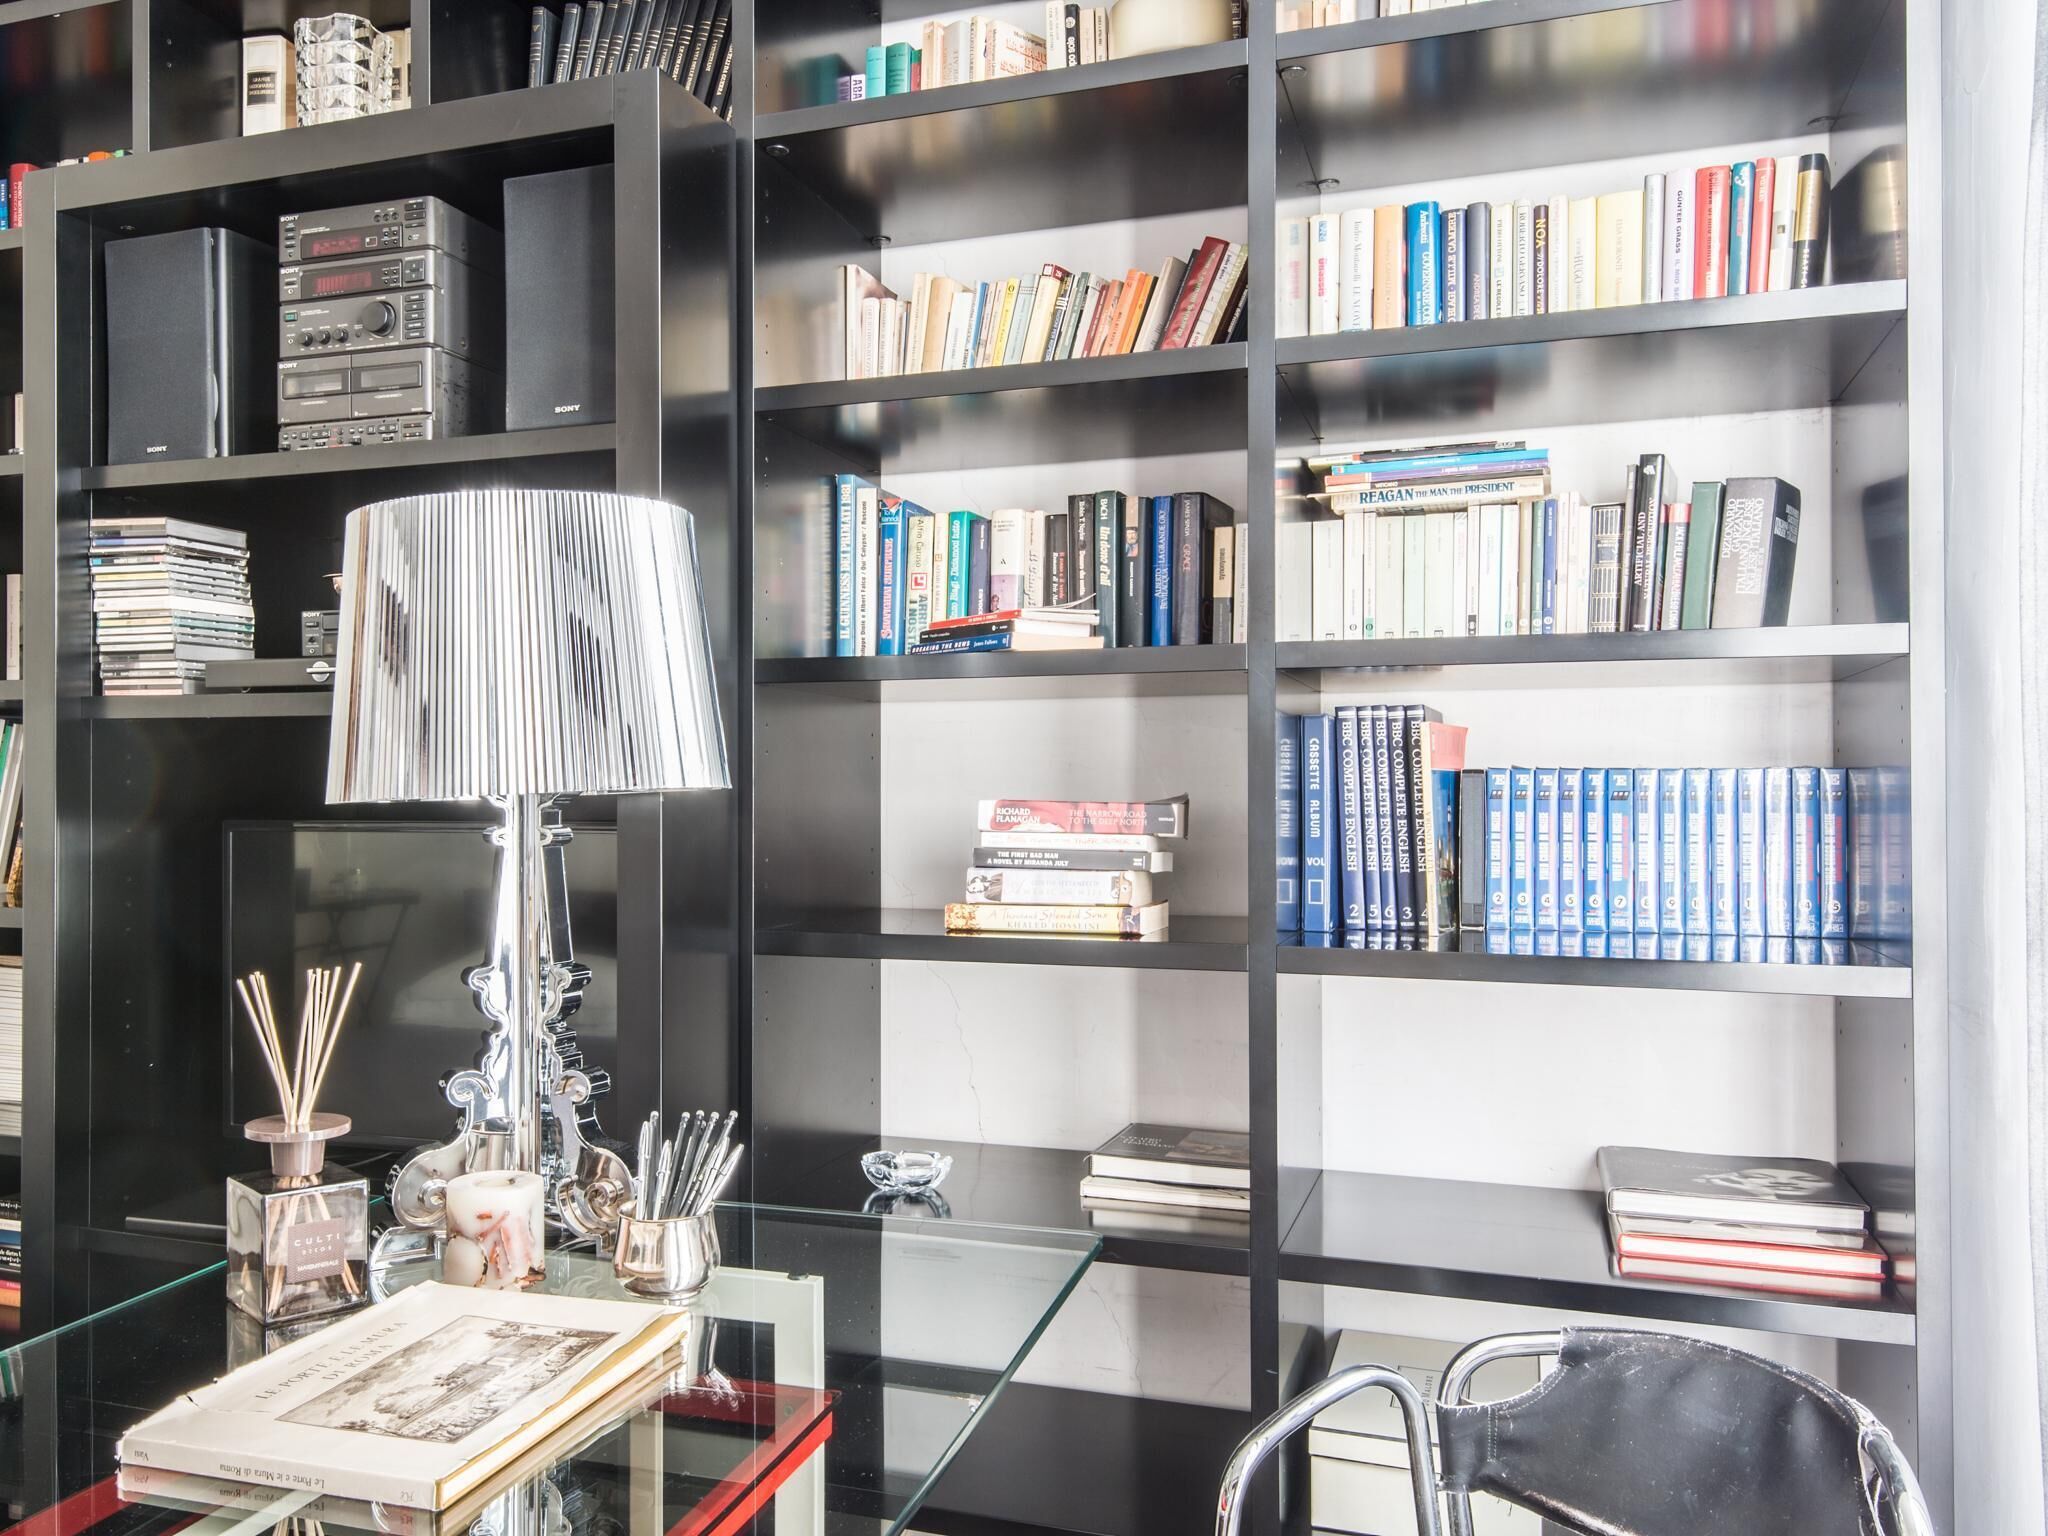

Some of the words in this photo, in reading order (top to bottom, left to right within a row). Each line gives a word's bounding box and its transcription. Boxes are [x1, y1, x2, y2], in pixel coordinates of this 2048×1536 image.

[1676, 190, 1684, 223] GÜNTER
[1448, 212, 1457, 253] CAMERE
[1519, 212, 1527, 255] ROBERTO
[1535, 218, 1546, 249] NOA
[280, 267, 299, 275] SONY
[1223, 254, 1232, 266] John
[1447, 254, 1456, 285] MILLE
[1574, 255, 1584, 284] HUGO
[1518, 257, 1526, 297] GERVASO
[554, 405, 581, 414] SONY
[146, 445, 168, 454] SONY
[841, 484, 852, 504] 1981
[1359, 488, 1414, 505] REAGAN
[1414, 490, 1427, 498] THE
[1449, 487, 1463, 496] THE
[1464, 481, 1515, 495] PRESIDENT
[1100, 498, 1108, 520] BACH
[1741, 498, 1755, 541] INGLESE
[840, 505, 851, 553] PRIMATI
[917, 519, 925, 539] Alfio
[1636, 512, 1647, 532] AND
[1721, 498, 1737, 559] DIZIONARIO
[1731, 498, 1746, 552] GARZANTI
[1748, 498, 1764, 548] ITALIANO
[1157, 525, 1166, 554] GRANDE
[840, 555, 851, 572] DEI
[915, 541, 925, 568] Caruso
[1100, 541, 1111, 564] dono
[1183, 543, 1191, 572] GRACE
[1634, 533, 1646, 586] ARTIFICIAL
[1735, 544, 1749, 594] ITALIANO
[1744, 551, 1757, 594] INGLESE
[1154, 568, 1162, 598] ALBERTO
[840, 573, 851, 627] GUINNESS
[840, 628, 851, 639] IL
[911, 644, 940, 653] BREAKING
[1342, 721, 1353, 746] BBC
[1360, 721, 1371, 746] BBC
[1376, 720, 1386, 745] BBC
[1392, 722, 1402, 747] BBC
[1410, 720, 1421, 745] BBC
[1310, 738, 1320, 790] CASSETTE
[1343, 749, 1355, 815] COMPLETE
[1362, 749, 1374, 815] COMPLETE
[1378, 749, 1389, 815] COMPLETE
[1394, 750, 1406, 816] COMPLETE
[1412, 749, 1424, 815] COMPLETE
[995, 808, 1031, 816] RICHARD
[995, 815, 1041, 824] FLANAGAN
[1069, 809, 1083, 817] THE
[1086, 810, 1121, 818] NARROW
[1096, 818, 1117, 826] DEEP
[1310, 800, 1321, 838] ALBUM
[1345, 818, 1357, 871] ENGLISH
[1365, 818, 1377, 871] ENGLISH
[1381, 818, 1393, 872] ENGLISH
[1397, 819, 1410, 873] ENGLISH
[1415, 819, 1427, 872] ENGLISH
[1307, 857, 1325, 866] VOL
[1039, 909, 1080, 922] Splendid
[1349, 904, 1359, 917] 2
[1369, 904, 1378, 917] 5
[1384, 905, 1393, 918] 6
[1403, 907, 1412, 920] 3
[1007, 921, 1048, 929] KHALED
[1051, 922, 1101, 930] HOSSEINI
[294, 1233, 341, 1247] CULTI
[255, 1385, 281, 1400] LE
[279, 1363, 328, 1388] PORTE
[340, 1345, 361, 1356] LE
[360, 1321, 408, 1345] MURA
[322, 1370, 345, 1381] DI
[344, 1344, 393, 1369] ROMA
[219, 1463, 242, 1476] Roma
[243, 1468, 252, 1477] di
[254, 1469, 274, 1481] Mura
[276, 1472, 283, 1482] le
[292, 1474, 312, 1487] Porte
[314, 1478, 325, 1489] Le
